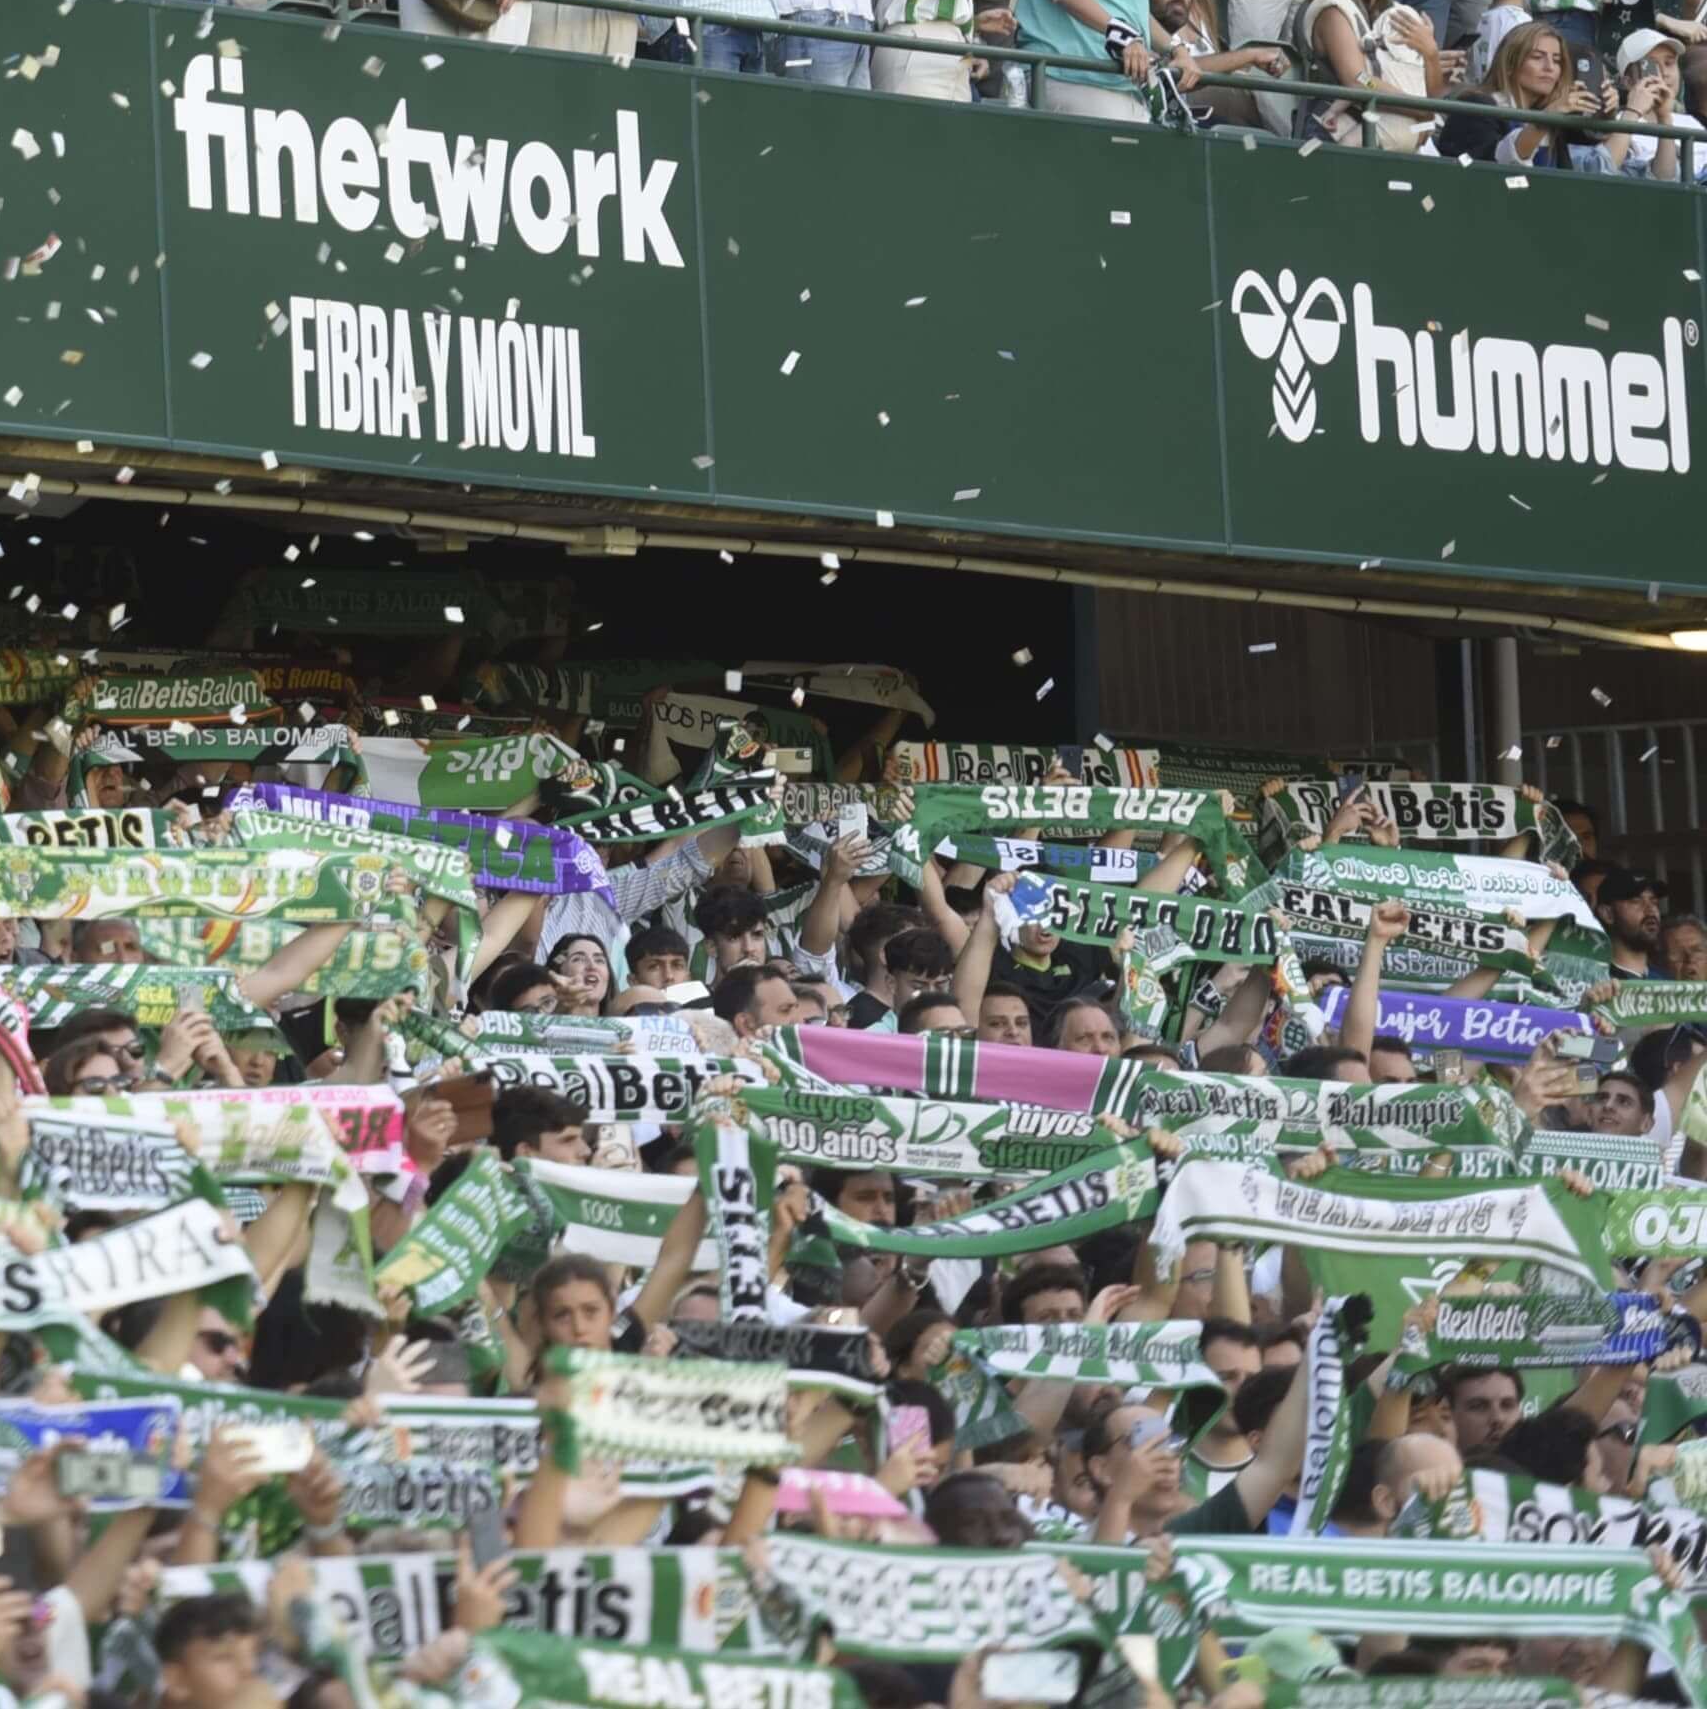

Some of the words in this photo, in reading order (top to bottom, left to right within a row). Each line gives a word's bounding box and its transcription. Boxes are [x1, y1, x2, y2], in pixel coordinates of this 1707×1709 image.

[173, 53, 685, 269] finetwork
[289, 295, 420, 442] FIBRA
[420, 309, 458, 442] Y
[460, 297, 595, 460] MÓVIL
[1353, 280, 1689, 474] hummel
[982, 786, 1089, 820] BETIS
[1113, 790, 1204, 824] REAL
[784, 1090, 874, 1123] tuyos
[1005, 1101, 1095, 1137] tuyos
[1143, 1089, 1212, 1123] Real
[1207, 1085, 1278, 1122] Betis
[764, 1117, 817, 1153] 100
[821, 1126, 897, 1164] años
[989, 1170, 1110, 1232] BETIS
[1437, 1303, 1530, 1343] RealBetis
[1249, 1560, 1337, 1598] REAL
[1343, 1566, 1434, 1601] BETIS
[1440, 1564, 1618, 1606] BALOMPIÉ
[579, 1647, 693, 1707] REAL
